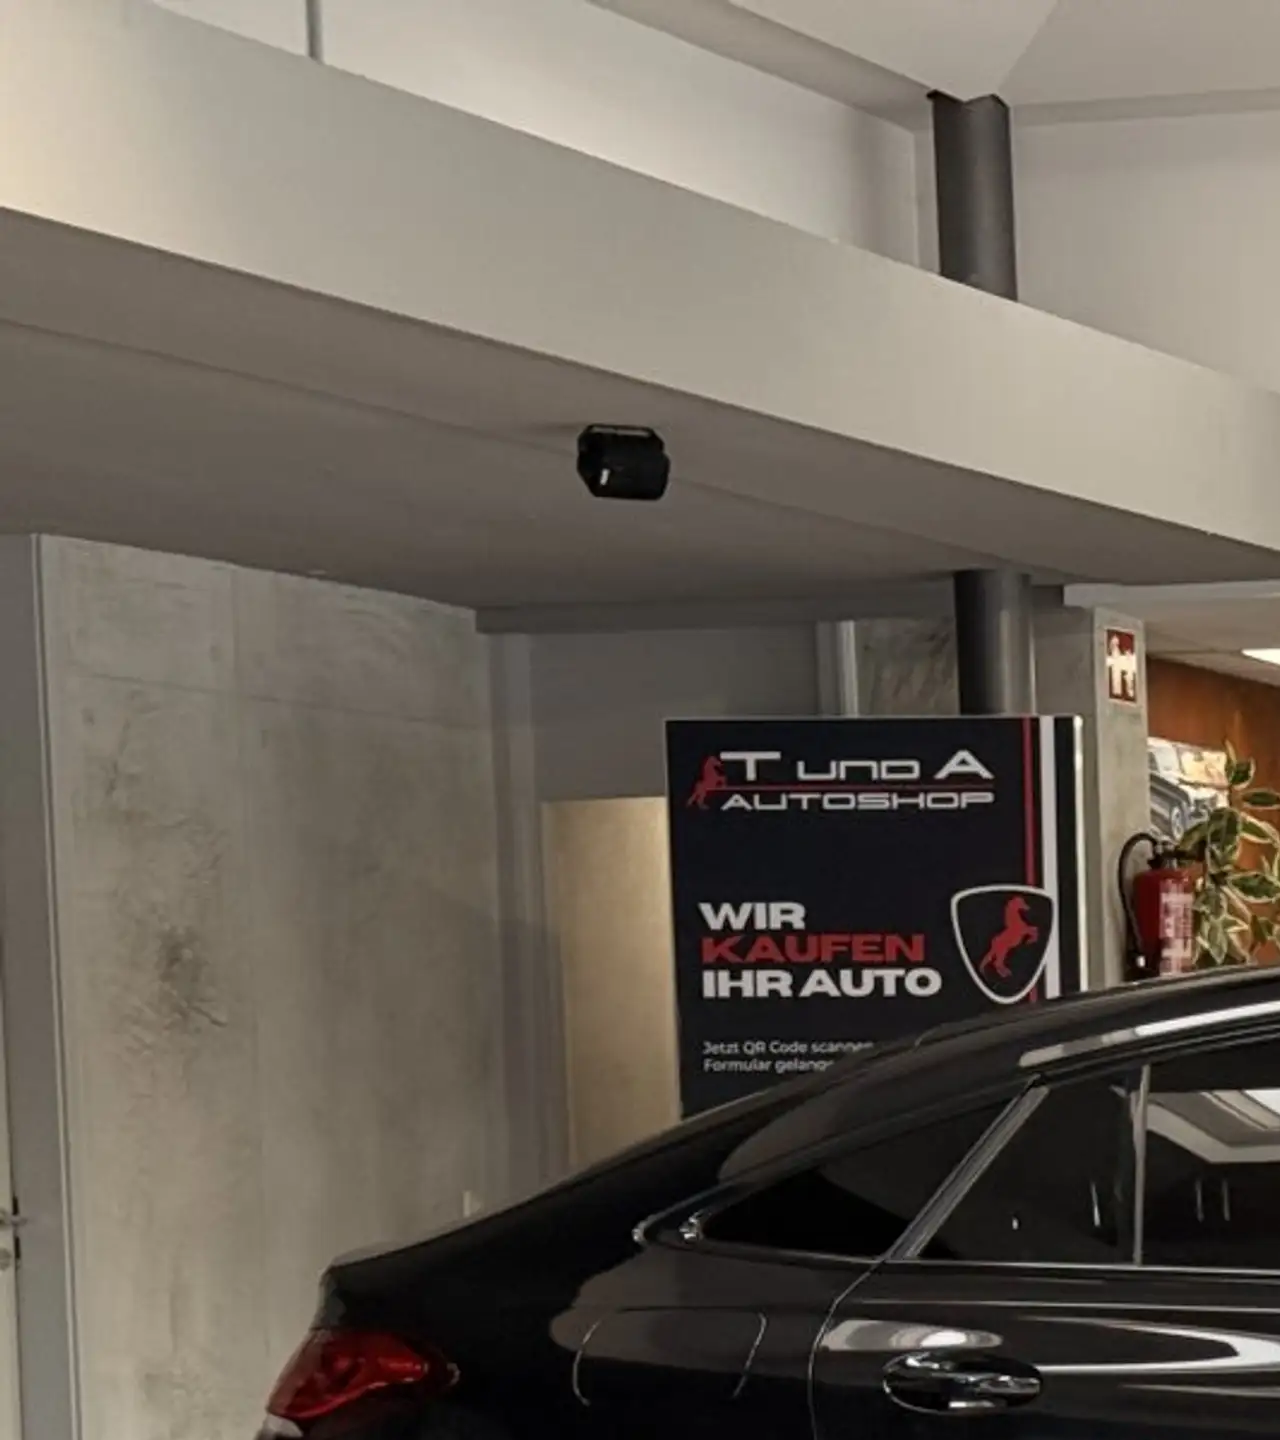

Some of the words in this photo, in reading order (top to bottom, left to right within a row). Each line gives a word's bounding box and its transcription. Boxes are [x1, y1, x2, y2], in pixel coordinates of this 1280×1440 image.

[720, 752, 781, 781] T
[934, 750, 994, 780] A
[721, 792, 994, 811] AUTOSHOP
[699, 902, 806, 931] WIR
[702, 934, 925, 963] KAUFEN
[703, 969, 793, 998] IHR
[799, 968, 942, 998] AUTO
[703, 1041, 740, 1055] Jetzt
[742, 1040, 766, 1056] QR
[769, 1040, 808, 1054] Code
[703, 1058, 773, 1072] Formular
